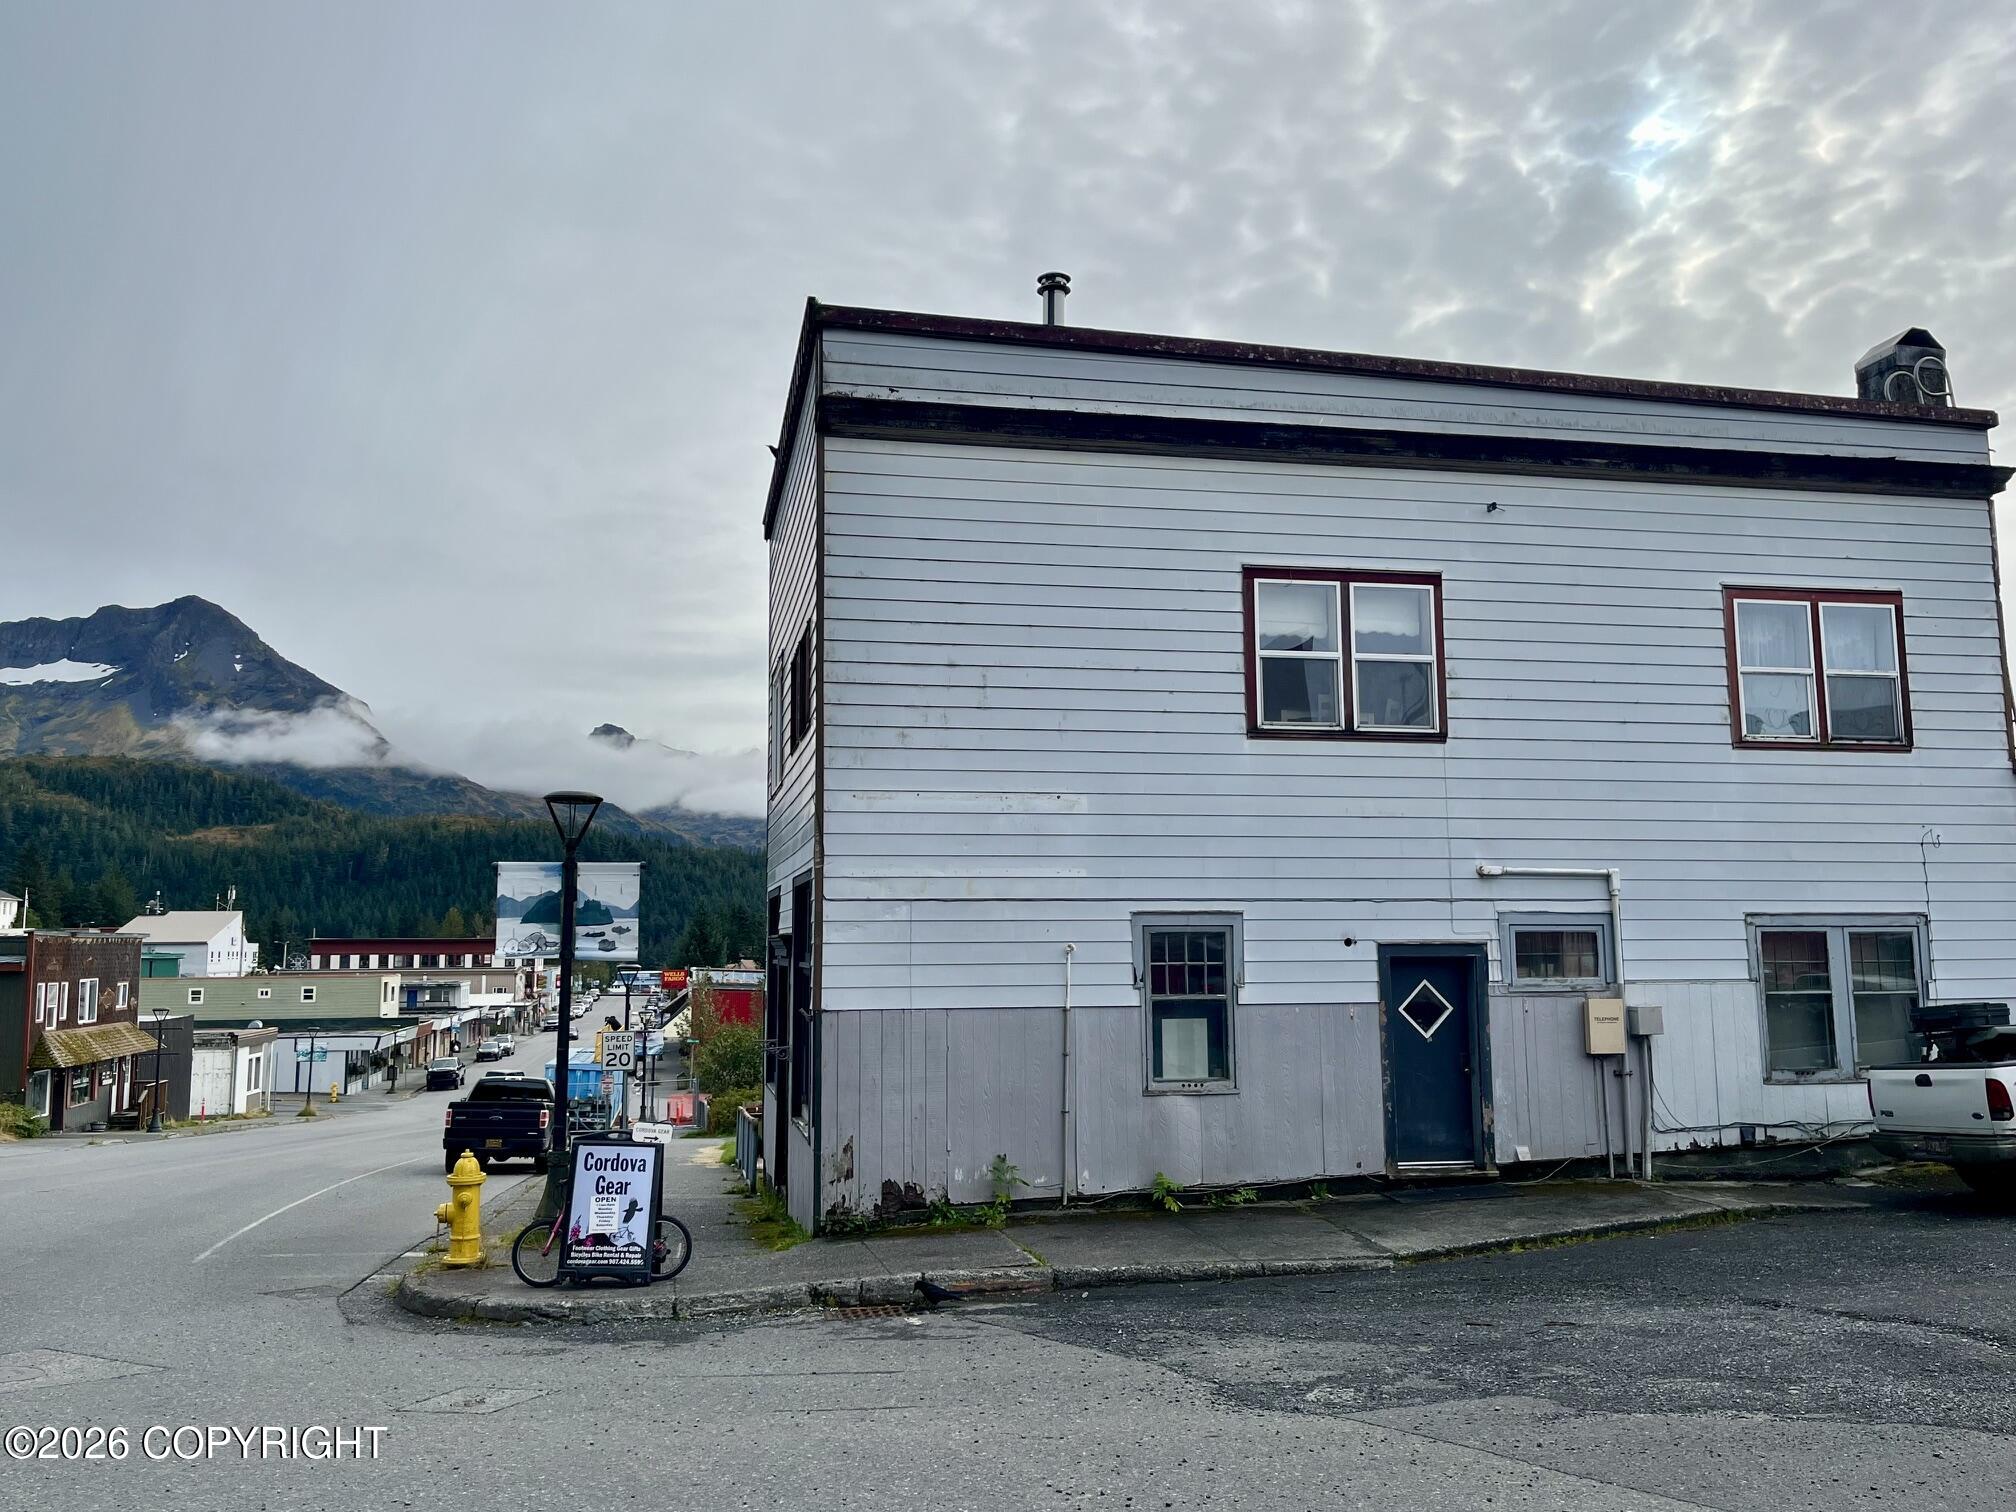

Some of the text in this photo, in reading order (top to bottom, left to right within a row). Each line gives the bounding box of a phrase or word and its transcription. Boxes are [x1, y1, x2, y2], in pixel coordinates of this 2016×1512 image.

[605, 1035, 633, 1043] SPEED
[606, 1052, 630, 1067] 20
[584, 1152, 646, 1172] Cordova
[595, 1174, 632, 1195] Gear
